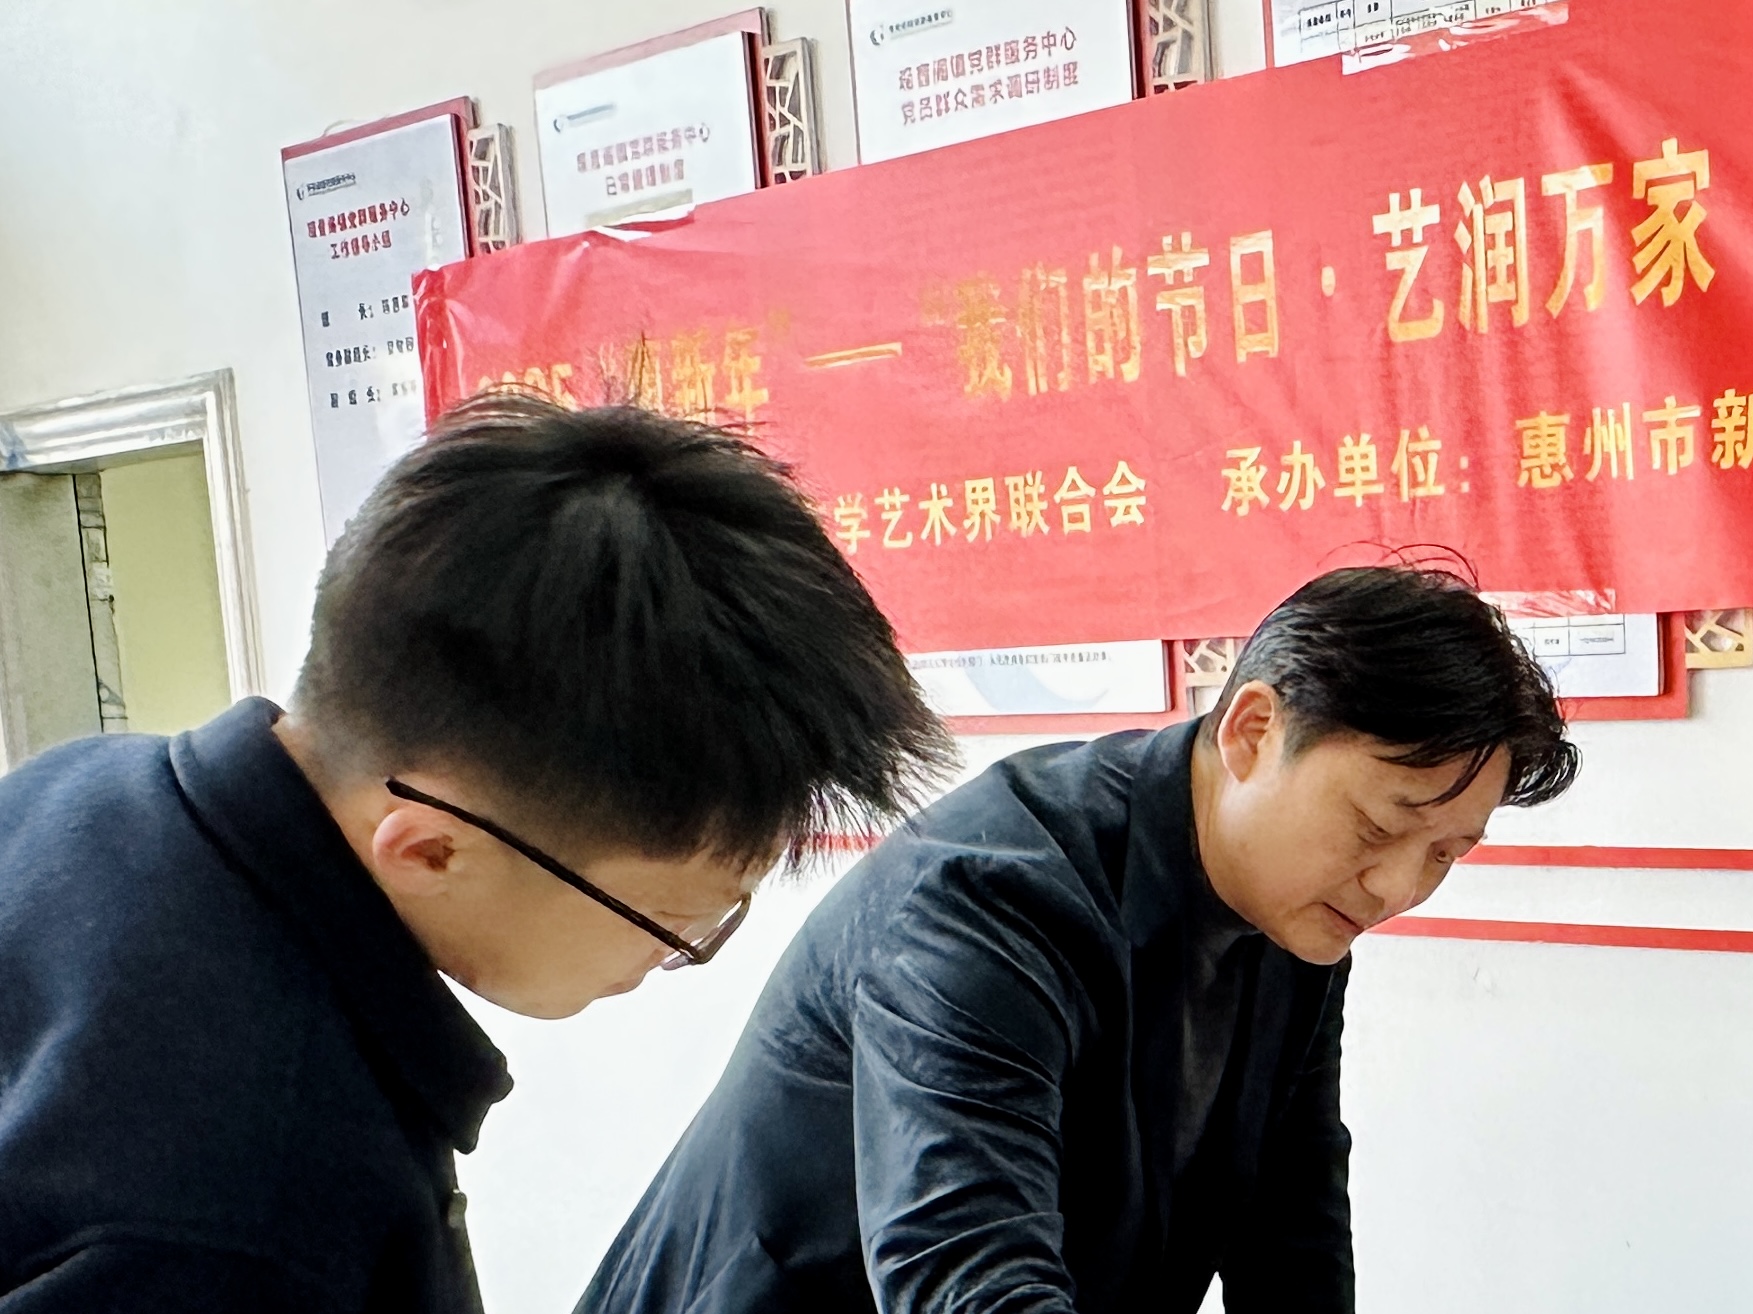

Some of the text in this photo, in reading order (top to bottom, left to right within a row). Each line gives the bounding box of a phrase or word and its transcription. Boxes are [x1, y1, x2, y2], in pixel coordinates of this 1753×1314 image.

[815, 460, 1147, 557] 学艺术界联合会
